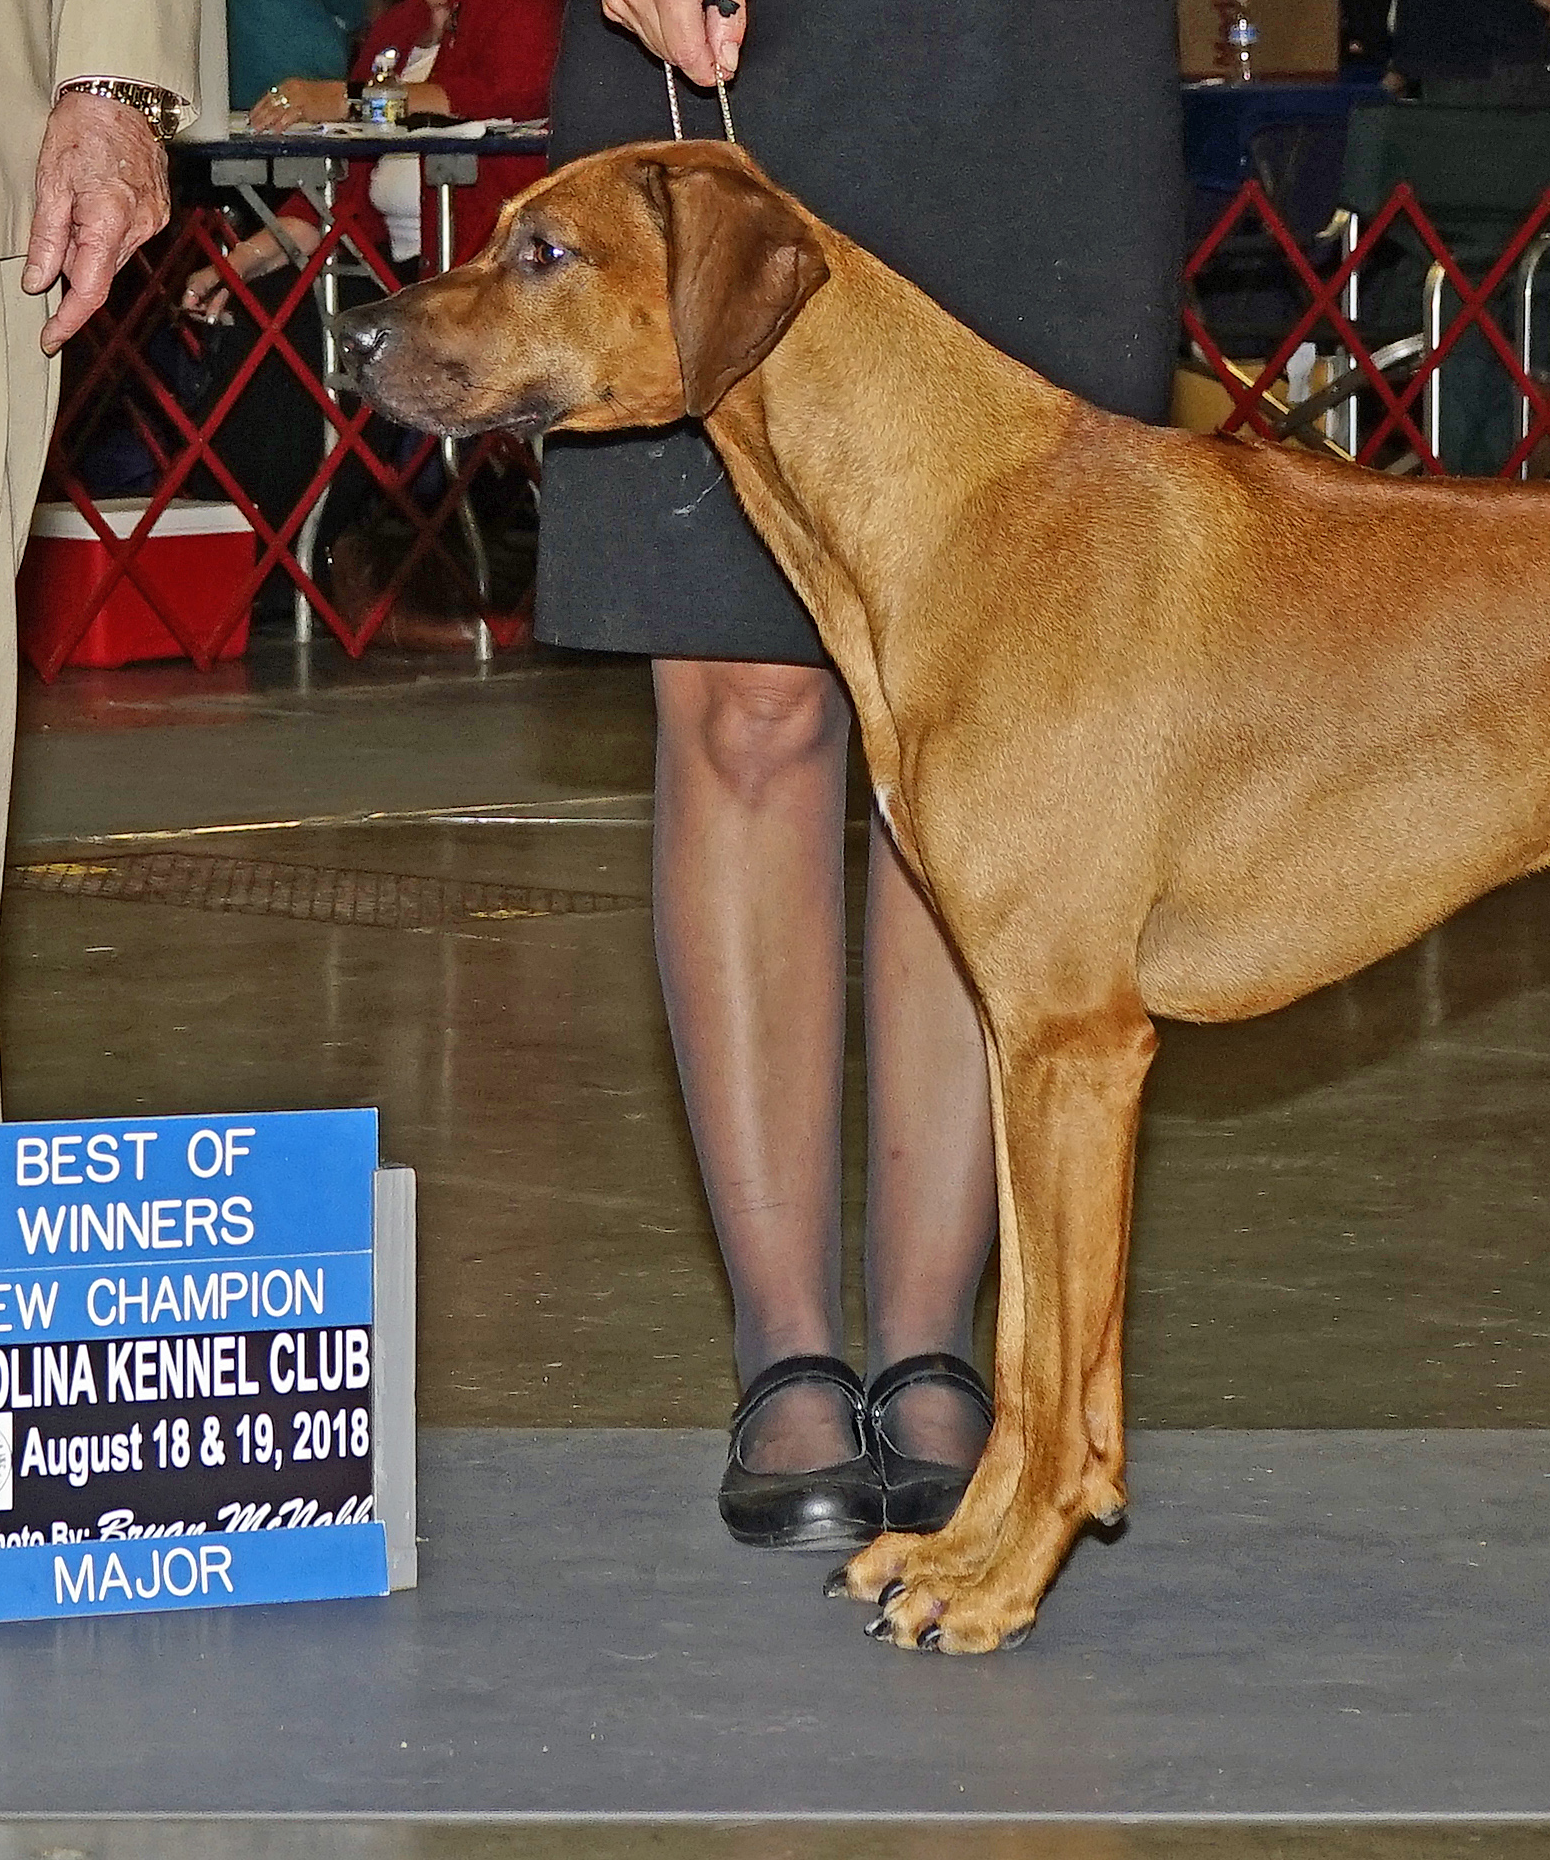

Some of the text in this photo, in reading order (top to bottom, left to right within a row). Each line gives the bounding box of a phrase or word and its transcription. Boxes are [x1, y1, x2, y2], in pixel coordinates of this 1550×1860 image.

[16, 1127, 256, 1186] BEST OF
[17, 1196, 255, 1255] WINNERS
[87, 1267, 324, 1327] CHAMPION
[108, 1335, 259, 1403] KENNEL
[269, 1328, 371, 1394] CLUB
[20, 1407, 369, 1487] August 18 & 19, 2018
[53, 1544, 234, 1605] MAJOR
